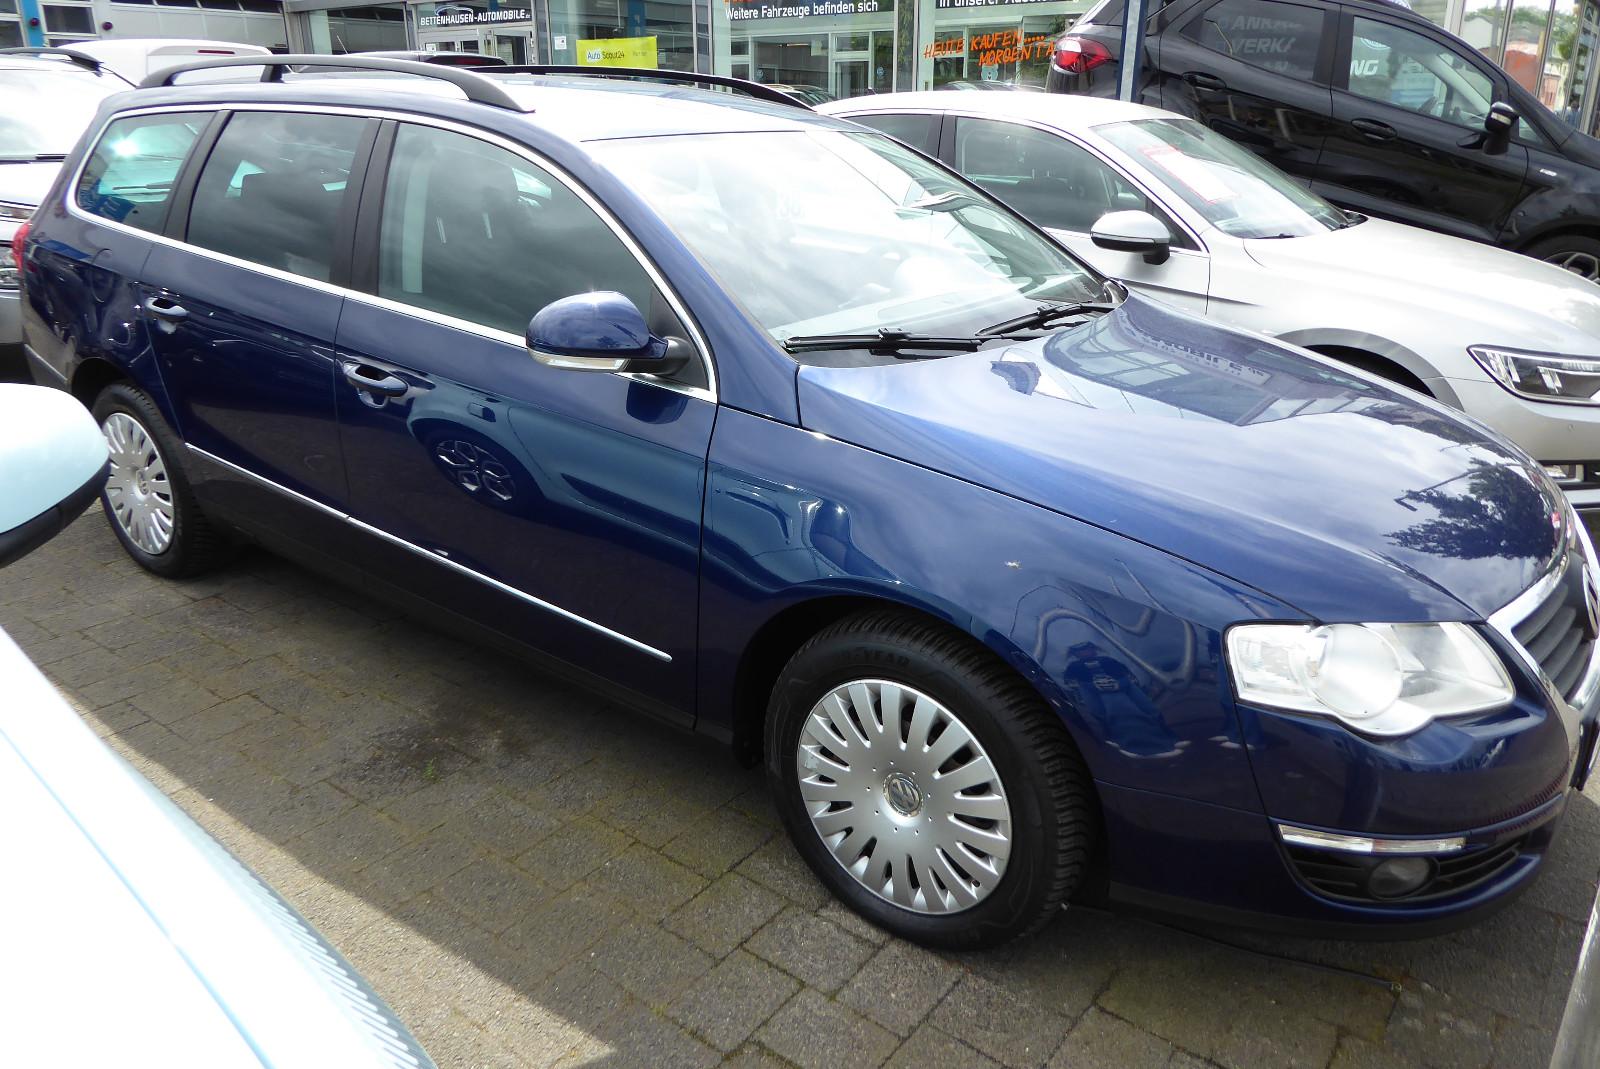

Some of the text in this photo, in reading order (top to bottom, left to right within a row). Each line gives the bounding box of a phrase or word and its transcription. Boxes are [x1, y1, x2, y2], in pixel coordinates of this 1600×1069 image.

[725, 0, 878, 20] Weitere Fahrzeuge befinden sich
[924, 37, 965, 59] HEUTE
[978, 45, 1032, 67] MORGEN
